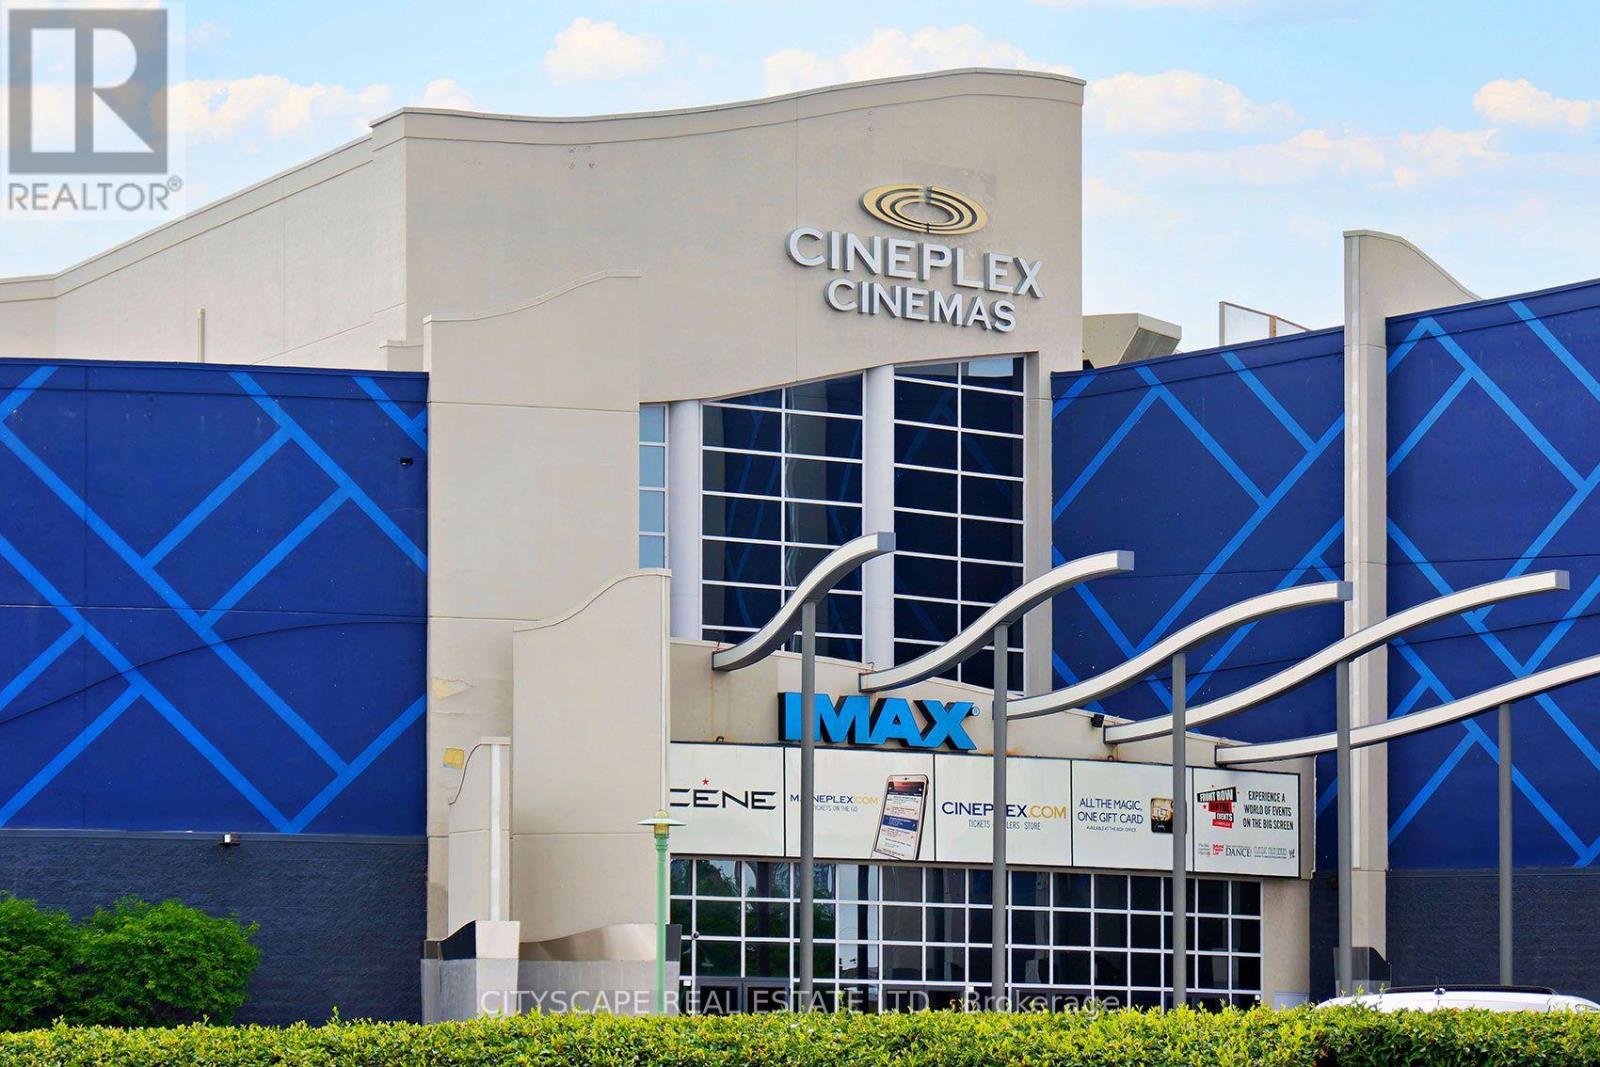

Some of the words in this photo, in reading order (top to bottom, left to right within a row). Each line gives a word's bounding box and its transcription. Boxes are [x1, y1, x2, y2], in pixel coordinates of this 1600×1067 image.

[785, 226, 1048, 299] CINEPLEX
[824, 277, 1017, 334] CINEMAS
[1248, 790, 1280, 802] EXPERIENCE
[1281, 792, 1286, 803] A
[941, 801, 1067, 819] CINEPEX.COM
[1079, 798, 1094, 808] ALL
[1095, 798, 1112, 809] THE
[1113, 799, 1142, 811] MAGIC,
[1243, 804, 1263, 815] WORLD
[1264, 805, 1271, 815] OF
[1272, 806, 1292, 817] EVENTS
[1077, 811, 1097, 822] ONE
[1098, 812, 1117, 823] GIFT
[1119, 813, 1144, 825] CARD
[1242, 817, 1251, 828] ON
[1252, 818, 1262, 829] THE
[1262, 819, 1272, 830] BIG
[1273, 820, 1294, 831] SCREEN
[968, 820, 990, 829] TICKETS
[1024, 821, 1041, 831] STORE
[1225, 847, 1252, 857] DANCE
